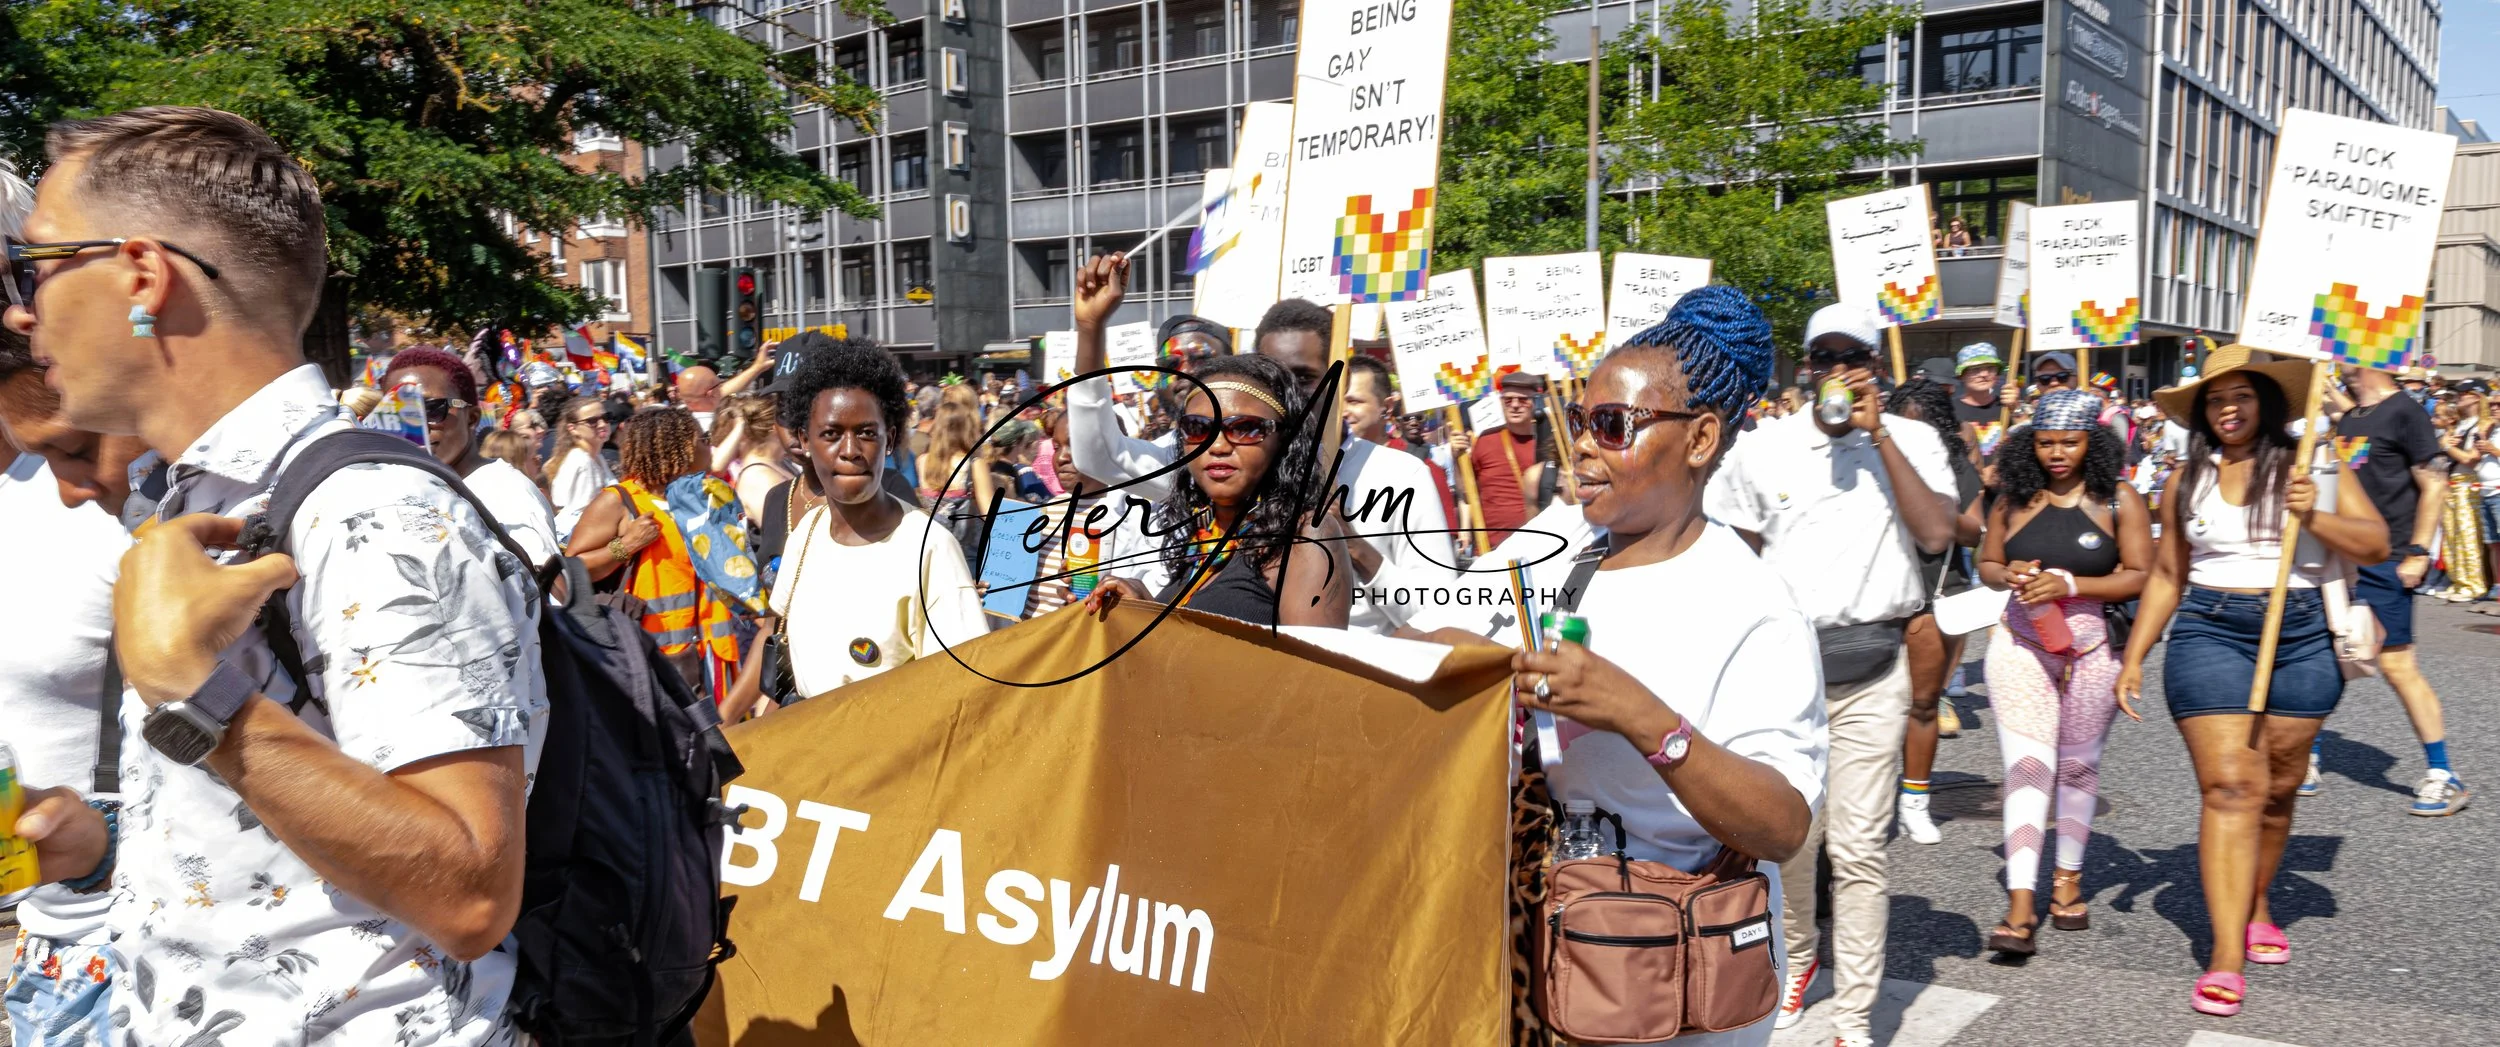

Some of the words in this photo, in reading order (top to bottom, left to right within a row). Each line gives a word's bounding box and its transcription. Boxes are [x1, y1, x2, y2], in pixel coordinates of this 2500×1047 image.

[1351, 0, 1416, 35] BEING
[1328, 47, 1372, 78] GAY
[1349, 79, 1406, 112] ISN'T
[1298, 114, 1435, 161] TEMPORARY!
[2333, 142, 2396, 170] FUCK
[2063, 218, 2102, 231] FUCK
[1292, 255, 1324, 274] LGBT
[1546, 264, 1582, 277] BEING
[1640, 267, 1680, 282] BEING
[1417, 286, 1456, 303] EING
[1624, 282, 1668, 298] TRANS
[2257, 311, 2298, 326] LGBT
[882, 828, 1214, 994] Asylum
